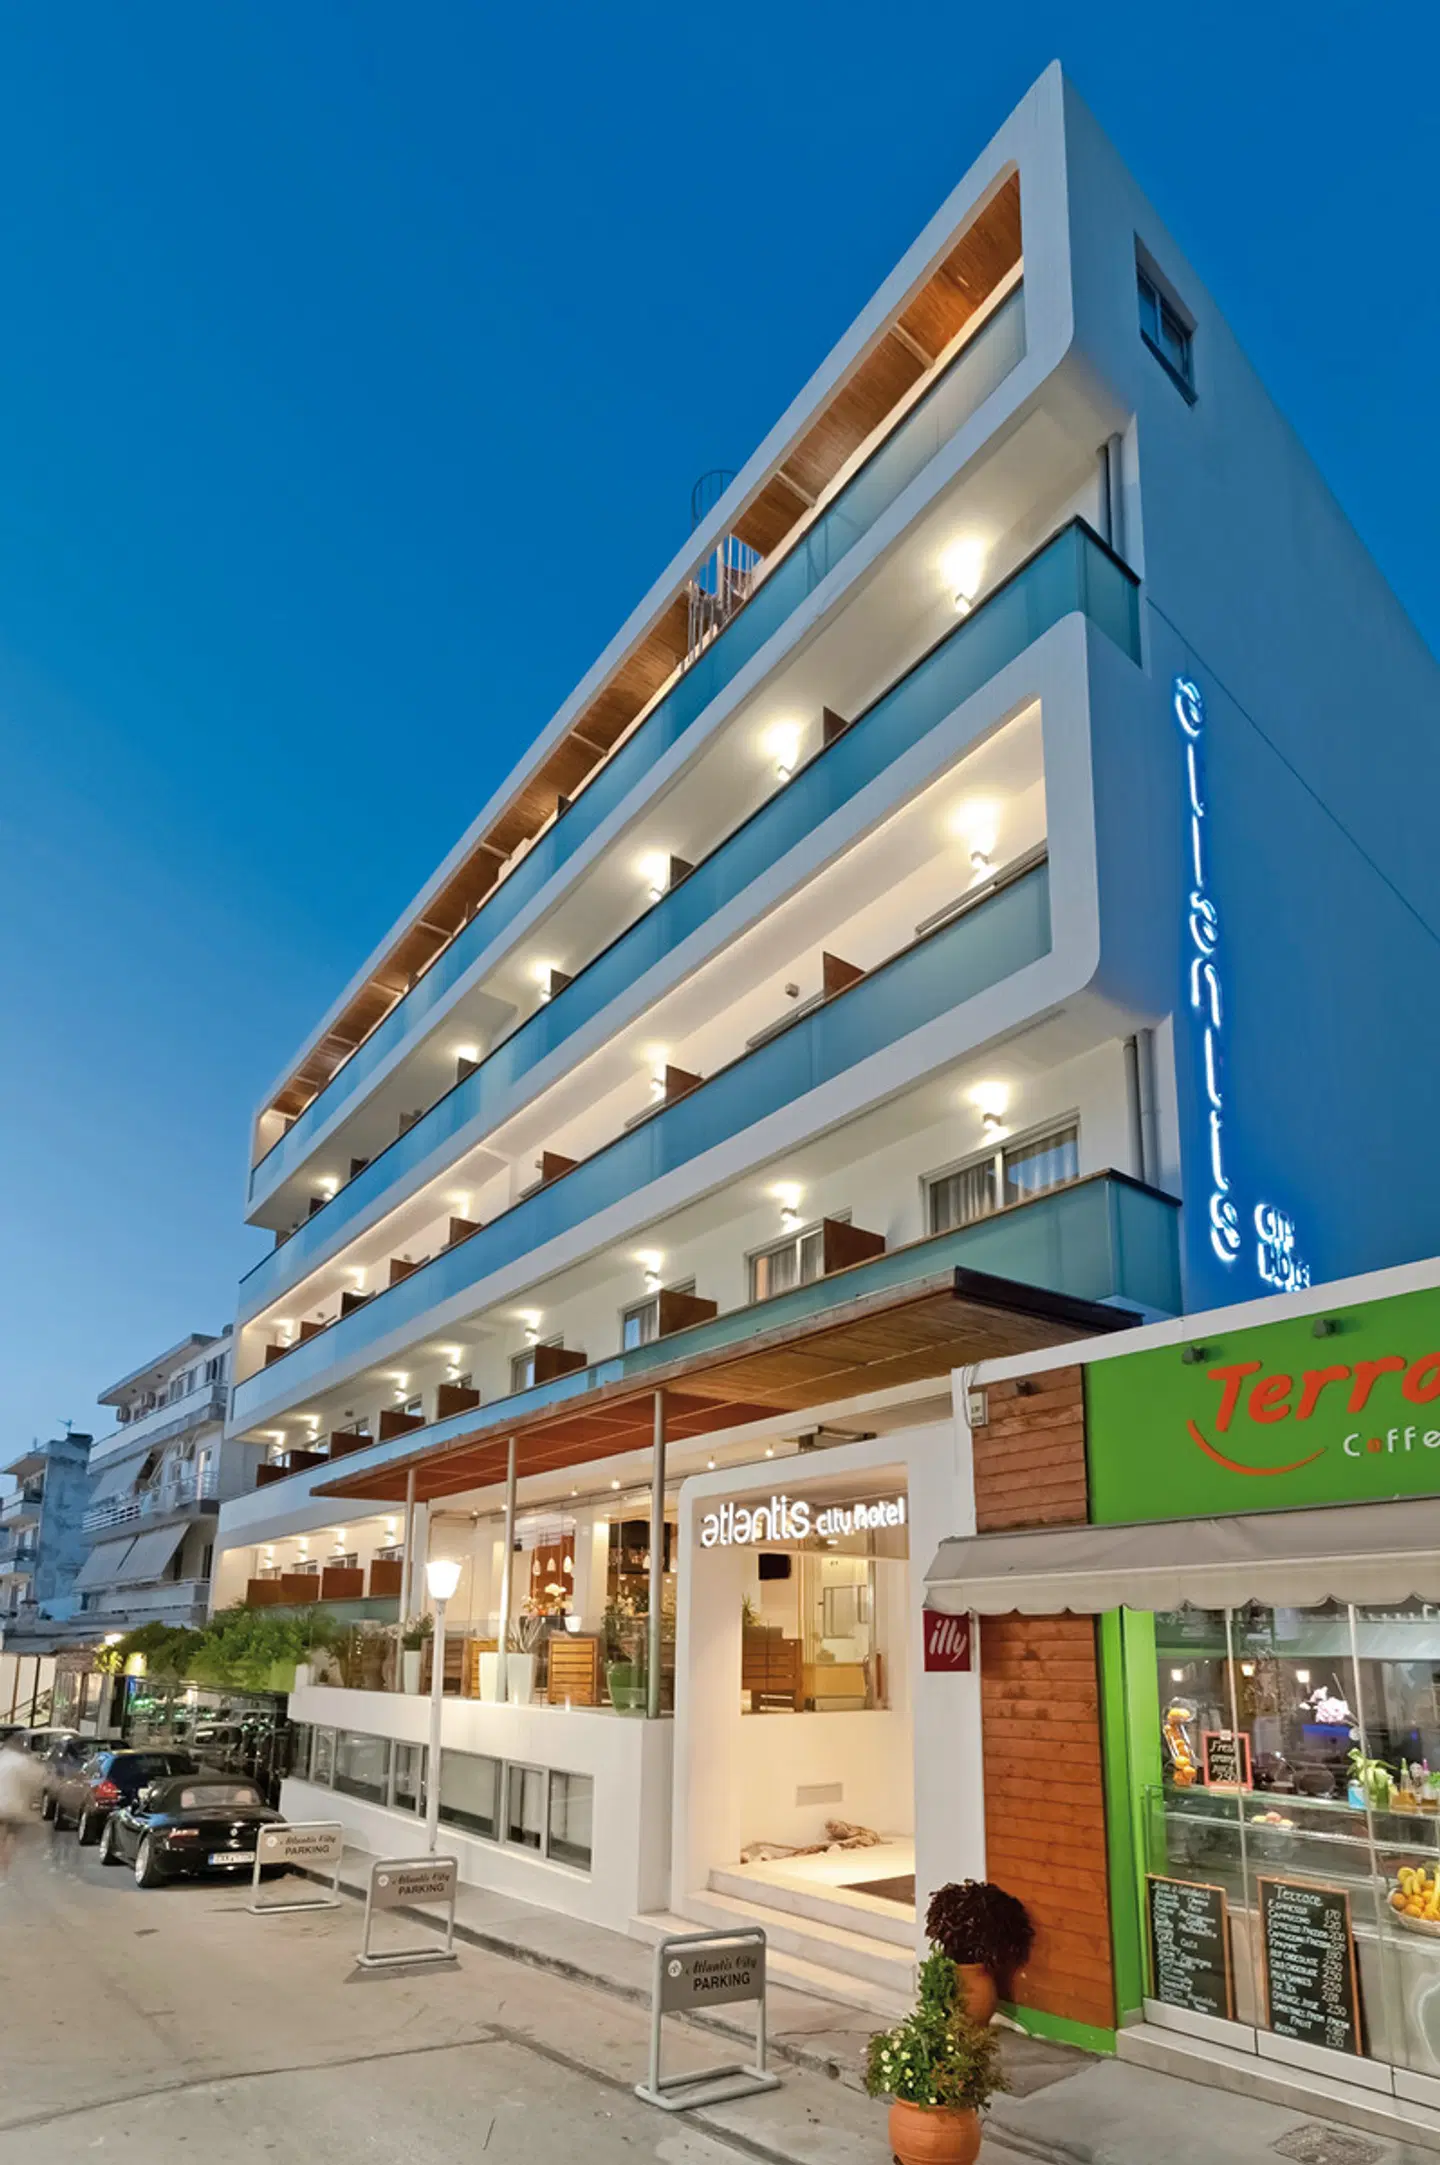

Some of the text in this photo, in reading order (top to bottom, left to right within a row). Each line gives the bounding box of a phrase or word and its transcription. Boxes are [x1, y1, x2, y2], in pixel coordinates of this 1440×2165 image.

[701, 1495, 905, 1547] atlantis city hotel
[929, 1619, 967, 1663] illy
[285, 1844, 330, 1855] PARKING
[398, 1882, 445, 1896] PARKING
[685, 1955, 732, 1976] Atlantis
[693, 1972, 751, 1992] PARKING
